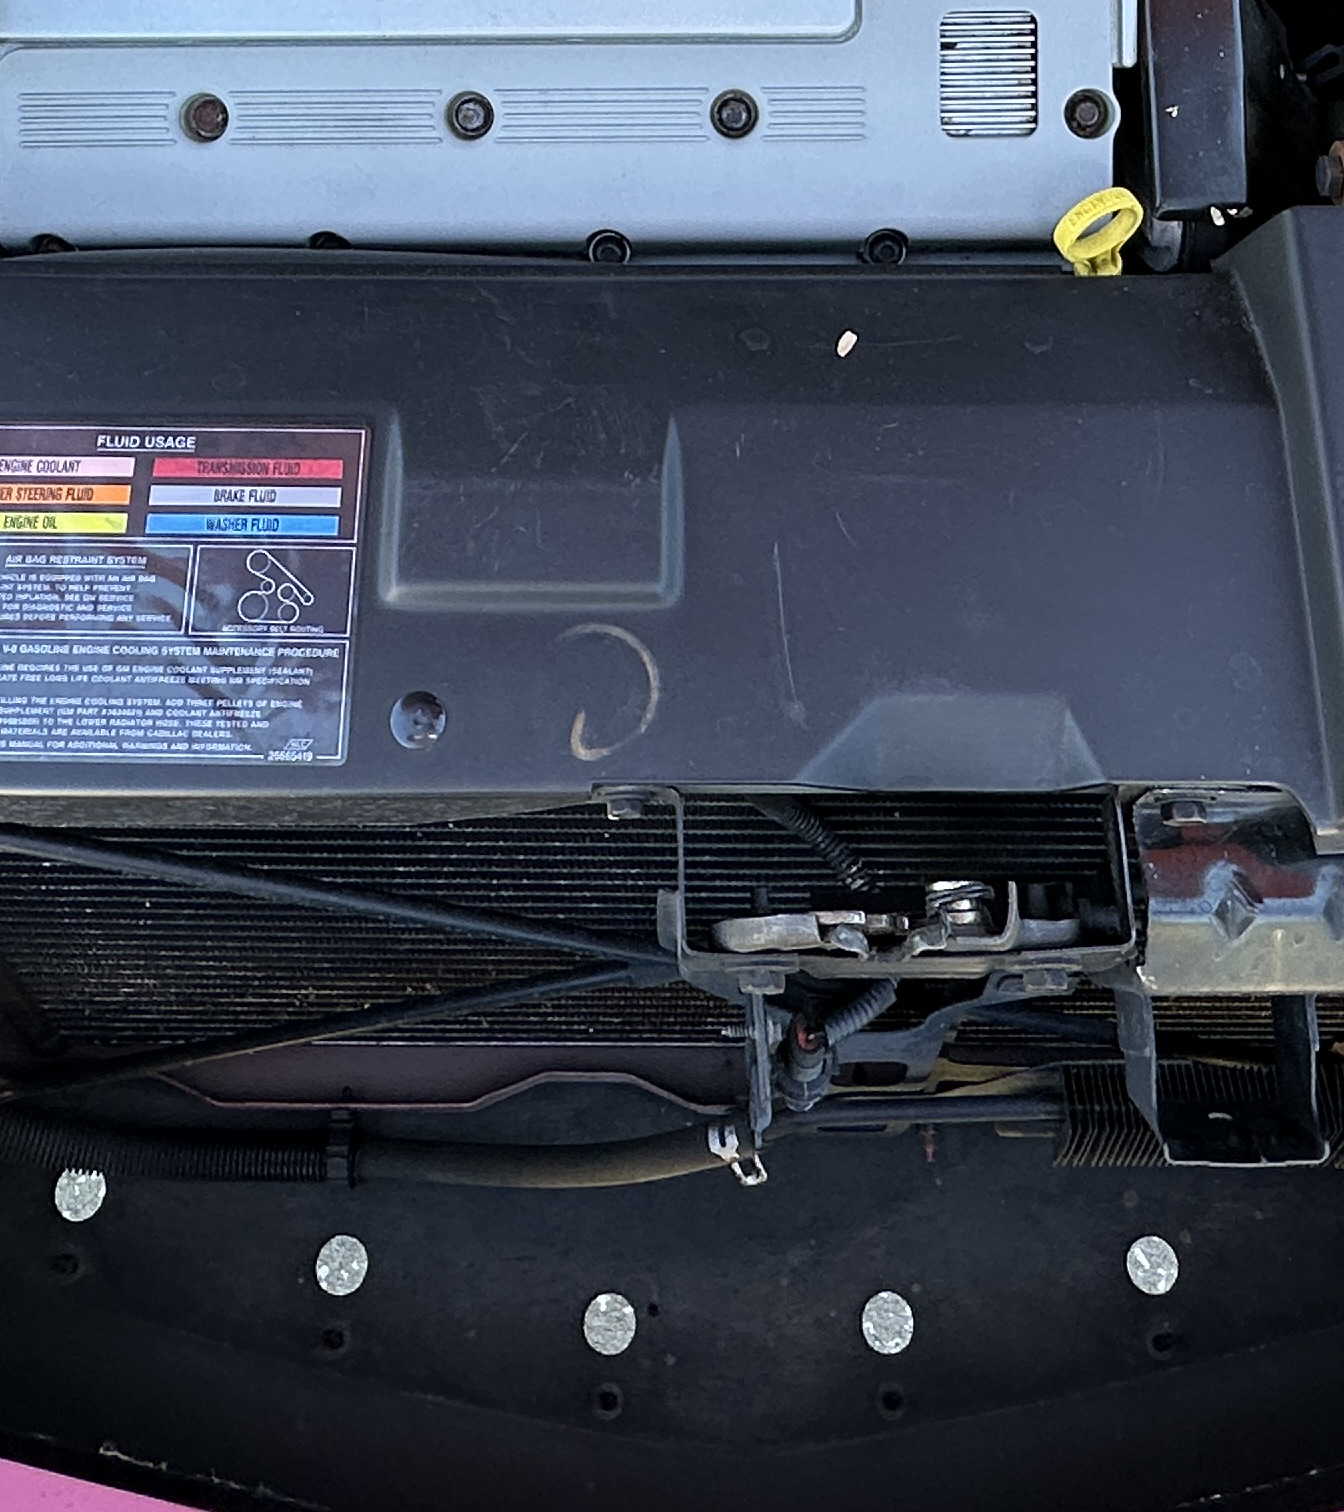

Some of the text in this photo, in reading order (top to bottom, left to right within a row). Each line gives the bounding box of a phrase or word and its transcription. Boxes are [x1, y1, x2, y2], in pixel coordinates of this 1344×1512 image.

[96, 435, 196, 447] FLUID USAGE
[36, 459, 81, 473] COOLANT
[196, 461, 301, 475] TRANSMISSION FLUID
[16, 487, 62, 501] STEERING
[65, 487, 94, 501] FLUID
[212, 488, 276, 502] BRAKE FLUID
[2, 515, 58, 529] ENGINE OIL
[205, 517, 279, 531] WASHER FLUID
